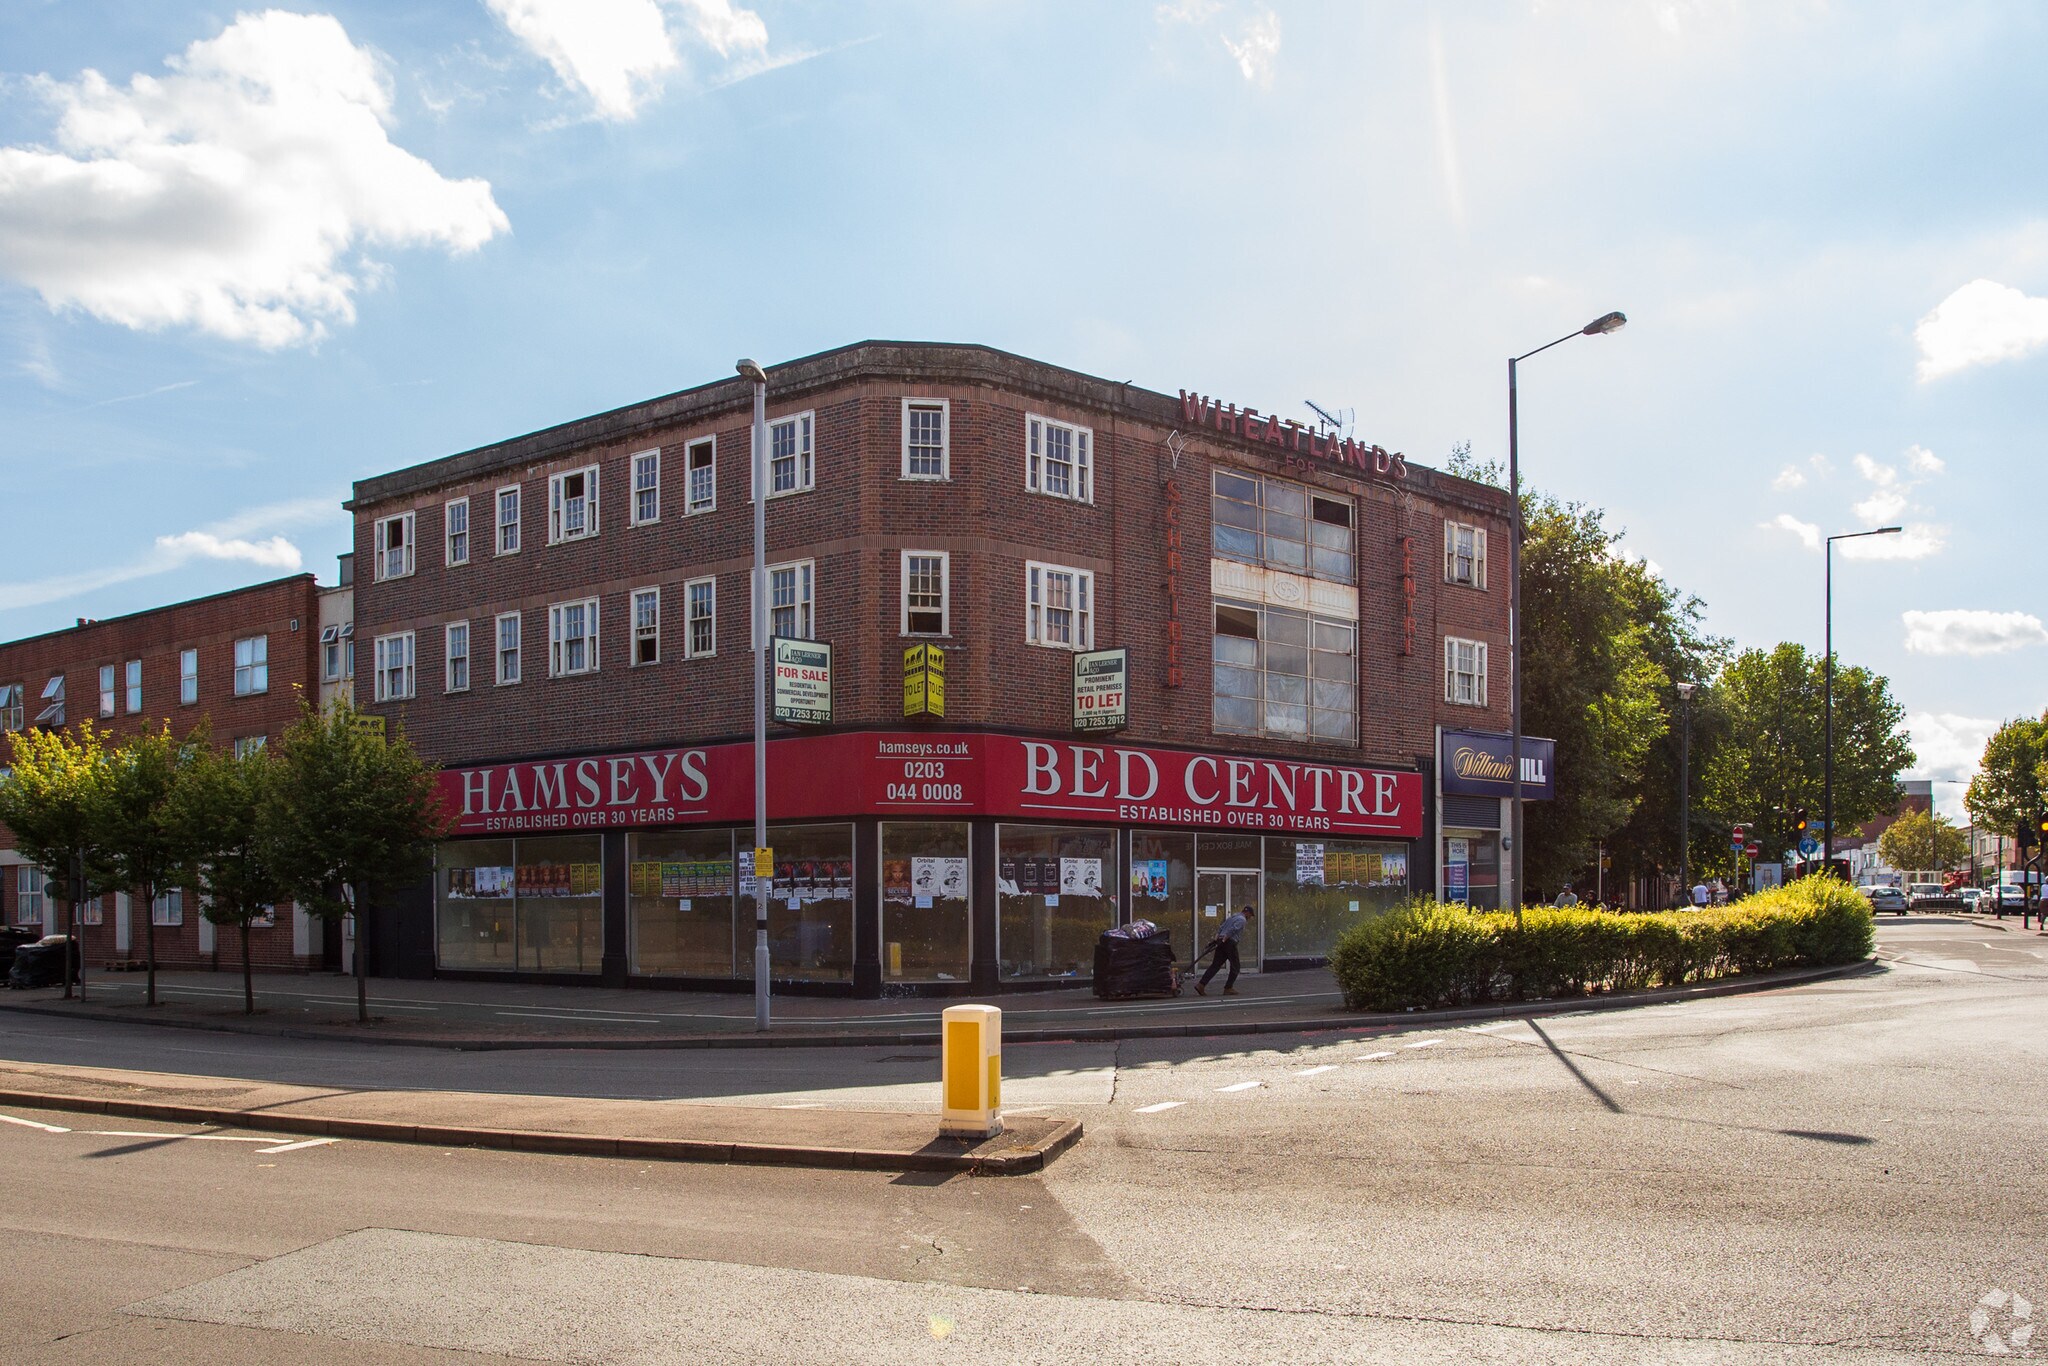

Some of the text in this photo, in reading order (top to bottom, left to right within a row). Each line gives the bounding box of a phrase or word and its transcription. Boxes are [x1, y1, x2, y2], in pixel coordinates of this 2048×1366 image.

[1179, 389, 1407, 480] WHEATLANDS
[1286, 455, 1316, 473] FOR
[1403, 537, 1417, 656] CENTRE
[778, 666, 828, 682] FOR SALE
[1085, 675, 1114, 684] PROMINENT
[802, 690, 828, 698] DEVELOPMENT
[905, 681, 924, 696] TO LET
[929, 681, 935, 693] TO
[1096, 683, 1122, 691] PREMISES
[790, 698, 816, 706] OPPORTUNITY
[1077, 693, 1122, 709] TO LET
[776, 707, 830, 720] 020 7253 2012
[1074, 716, 1125, 727] 020 7253 2012
[879, 740, 968, 756] hamseys.co.uk
[904, 762, 944, 778] 0203
[1453, 747, 1514, 780] William
[461, 751, 708, 815] HAMSEYS
[1021, 742, 1401, 818] BED CENTRE
[886, 784, 962, 800] 044 0008
[486, 807, 676, 830] ESTABLISHED OVER 30 YEARS
[1119, 804, 1330, 831] ESTABLISHED OVER 30 YEARS
